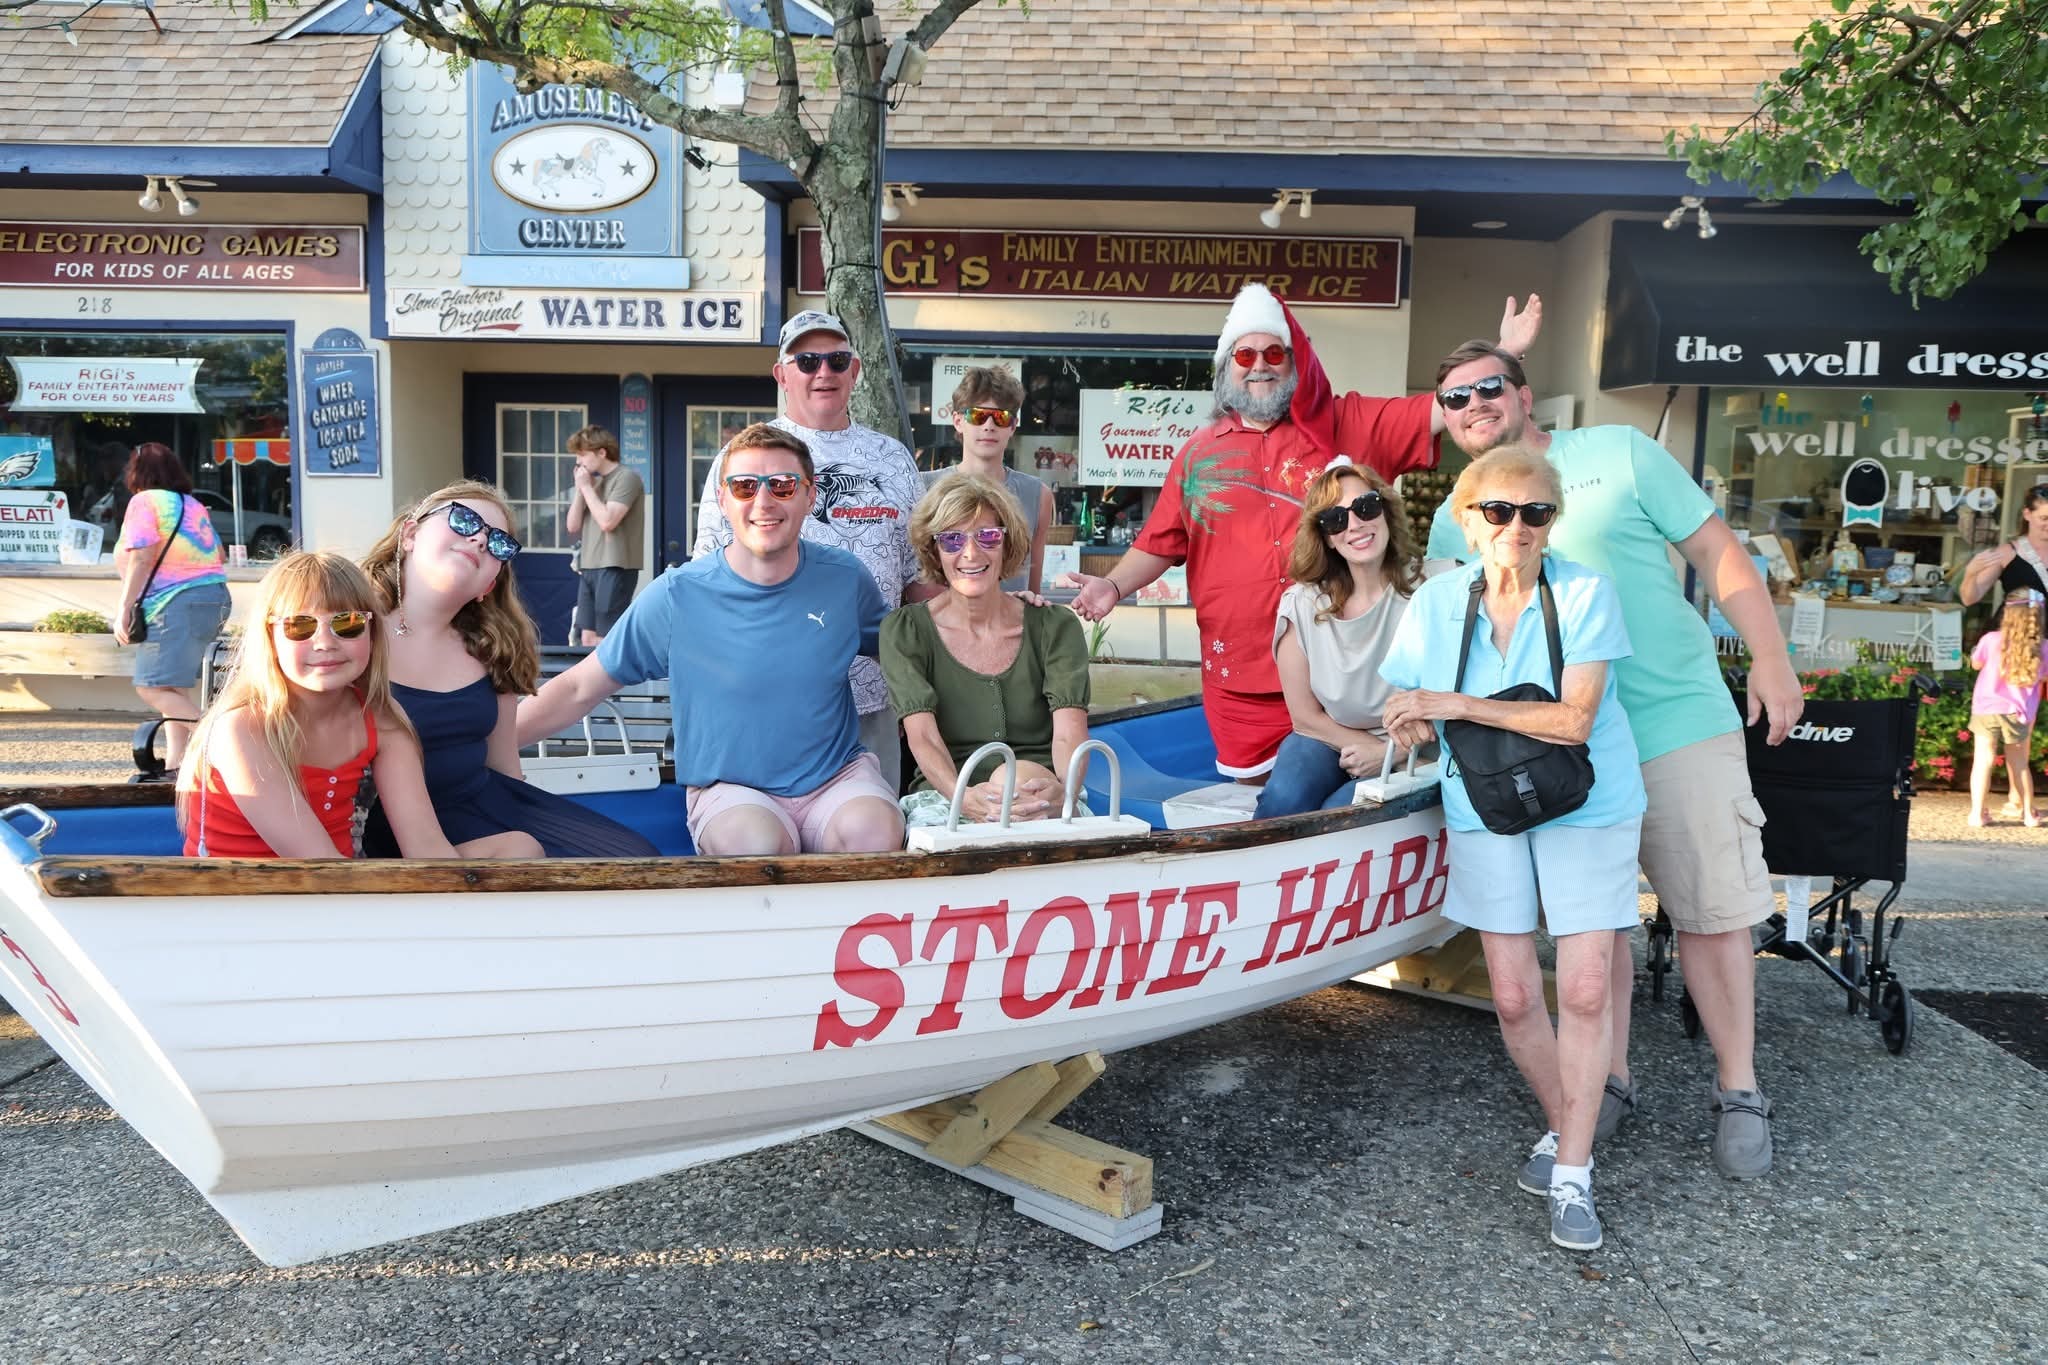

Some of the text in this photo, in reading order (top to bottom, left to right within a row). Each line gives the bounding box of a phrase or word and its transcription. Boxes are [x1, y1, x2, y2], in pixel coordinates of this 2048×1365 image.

[493, 87, 655, 131] AMUSEMEN
[521, 218, 626, 246] CENTER
[0, 231, 339, 257] ELECTRONIC GAMES
[54, 263, 295, 280] FOR KIDS OF ALL AGES
[882, 239, 991, 287] Gi's
[1018, 269, 1149, 292] ITALIAN
[1307, 276, 1367, 297] ICE
[78, 296, 112, 314] 218
[439, 300, 524, 332] Original
[540, 298, 742, 328] WATER ICE
[1675, 335, 2048, 379] the well dress
[944, 364, 969, 376] FRES
[28, 382, 185, 392] FAMILY ENTERTAINMENT
[41, 392, 175, 402] FOR OVER 50 YEARS
[318, 381, 355, 404] WATER
[311, 400, 368, 427] GATORADE
[346, 421, 366, 441] TEA
[1100, 422, 1199, 440] Gourmet Ital
[1104, 443, 1174, 460] WATER
[1746, 421, 2048, 465] well dresse
[330, 445, 360, 468] SODA
[1123, 469, 1146, 479] With
[1148, 469, 1168, 479] Fres
[0, 507, 54, 522] ELATI
[0, 543, 21, 553] ALIAN
[25, 544, 49, 553] WATER
[1715, 636, 1745, 656] LIVE
[1788, 721, 1854, 743] drive
[812, 828, 1449, 1051] STONE HARB
